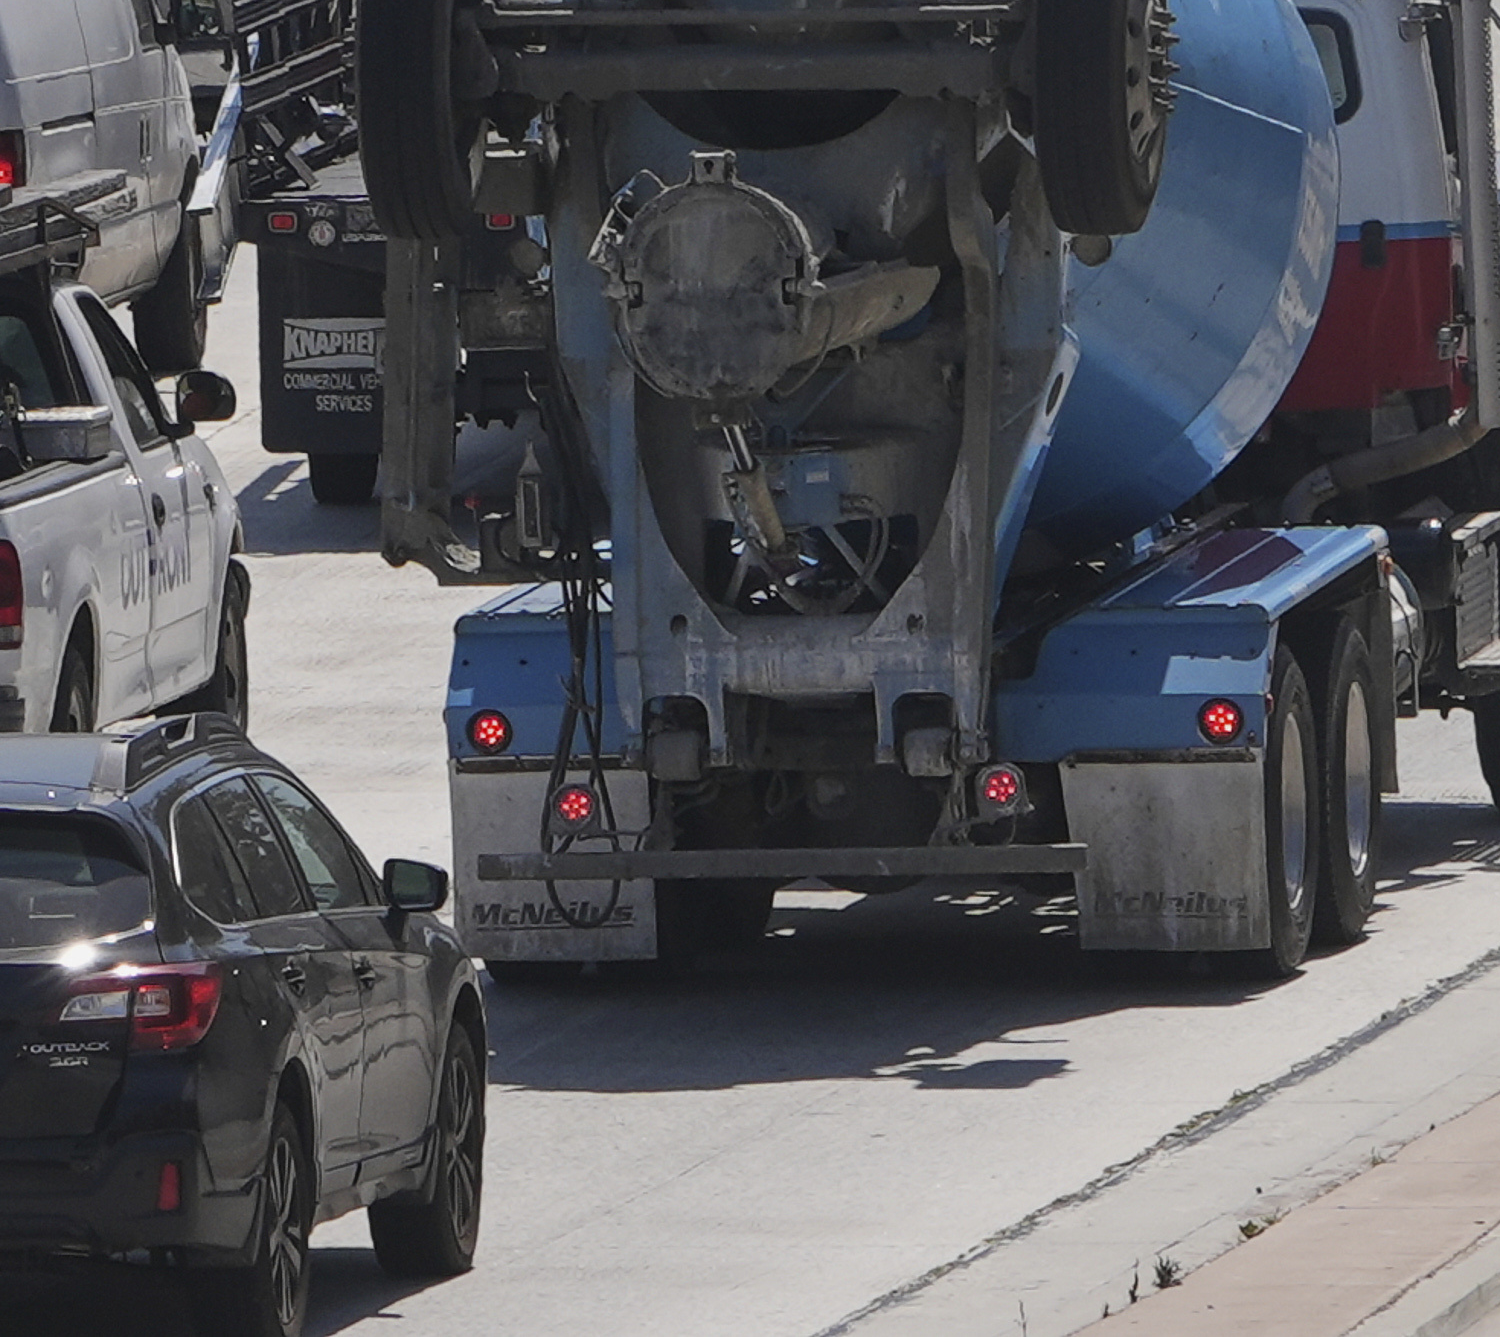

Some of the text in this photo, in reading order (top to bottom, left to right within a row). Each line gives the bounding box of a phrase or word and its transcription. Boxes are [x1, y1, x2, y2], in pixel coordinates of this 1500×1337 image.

[283, 325, 376, 361] KNAPHEI
[360, 373, 383, 390] VEH
[315, 393, 374, 413] SERVICES
[1093, 890, 1250, 914] McNeilus
[471, 903, 635, 929] McNeilus
[29, 1042, 110, 1055] OUTBACK
